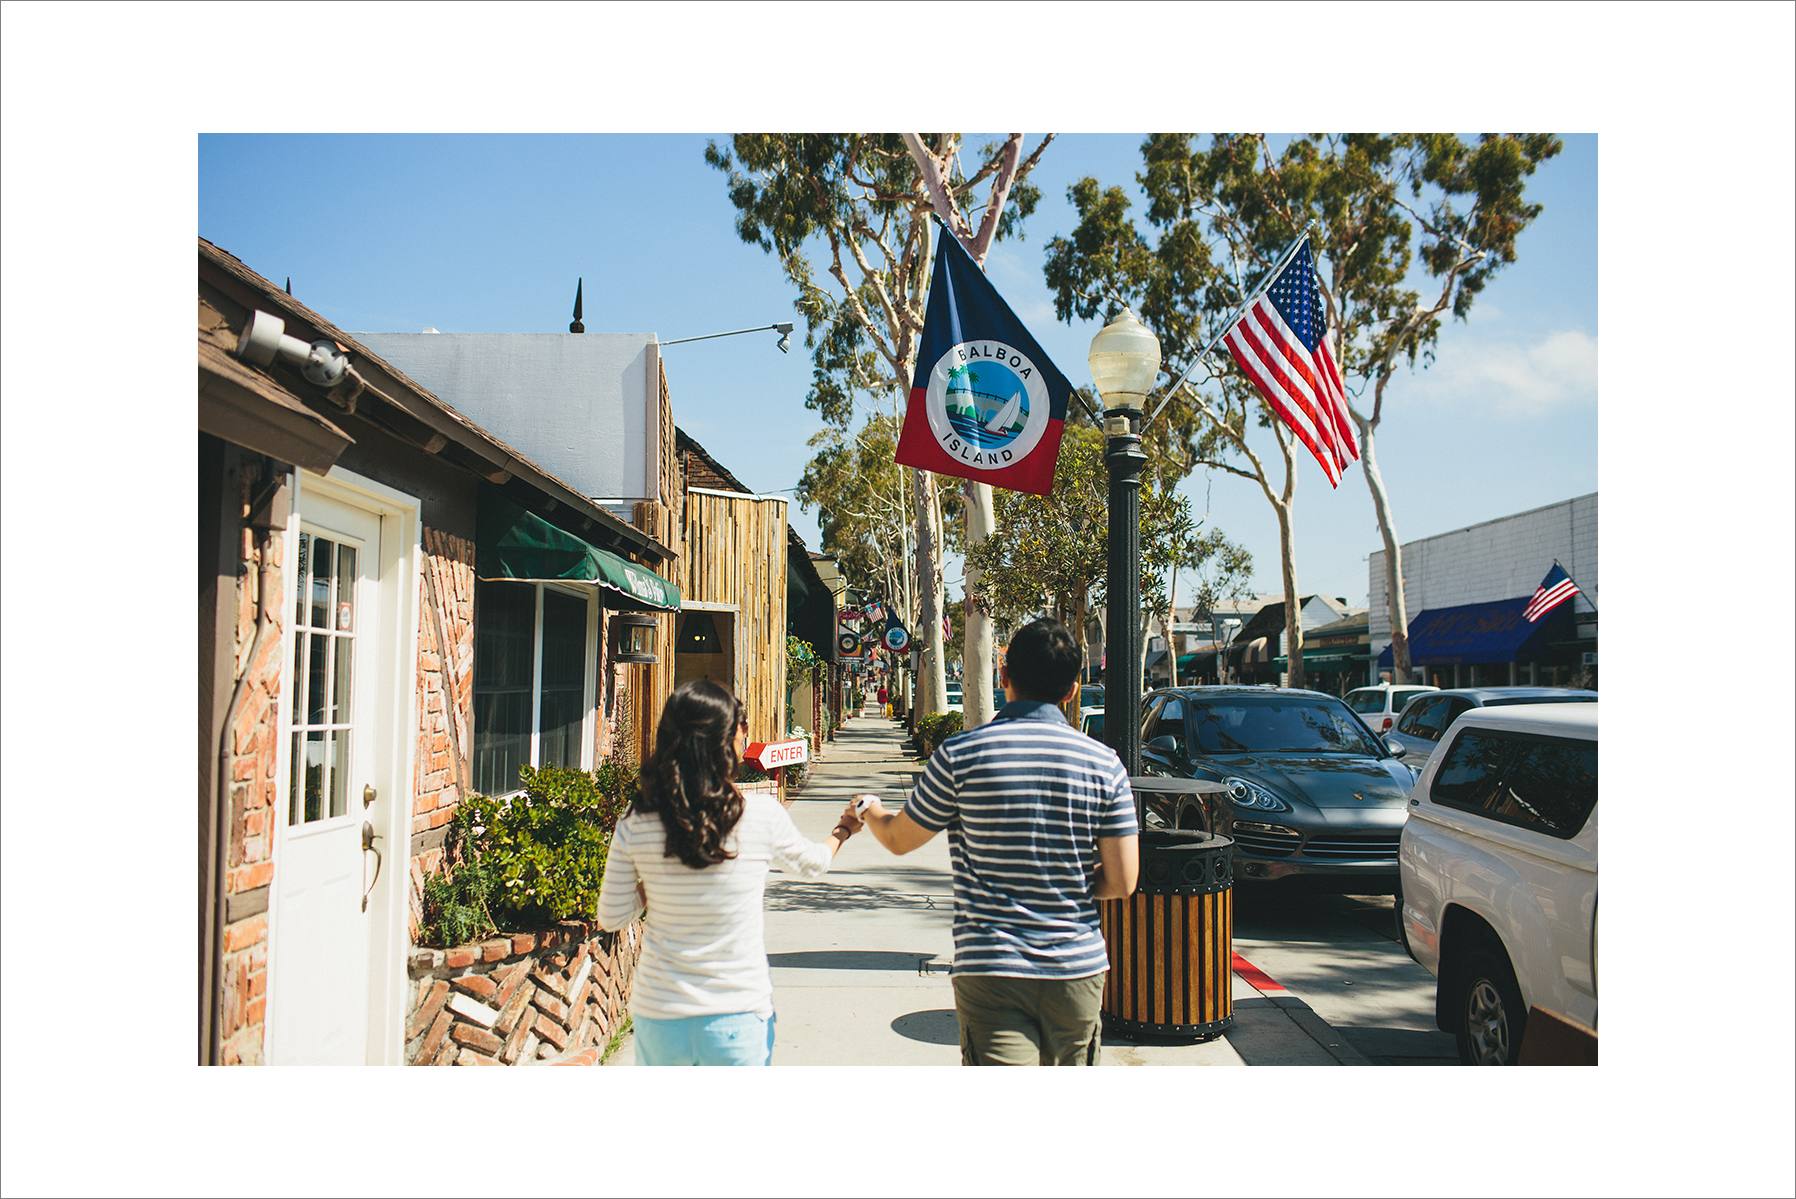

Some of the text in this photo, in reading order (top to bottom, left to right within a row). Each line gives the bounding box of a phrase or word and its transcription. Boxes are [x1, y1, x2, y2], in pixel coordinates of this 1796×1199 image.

[958, 345, 1033, 380] BALBOA
[942, 432, 1013, 465] ISLAND
[770, 745, 803, 764] ENTER
